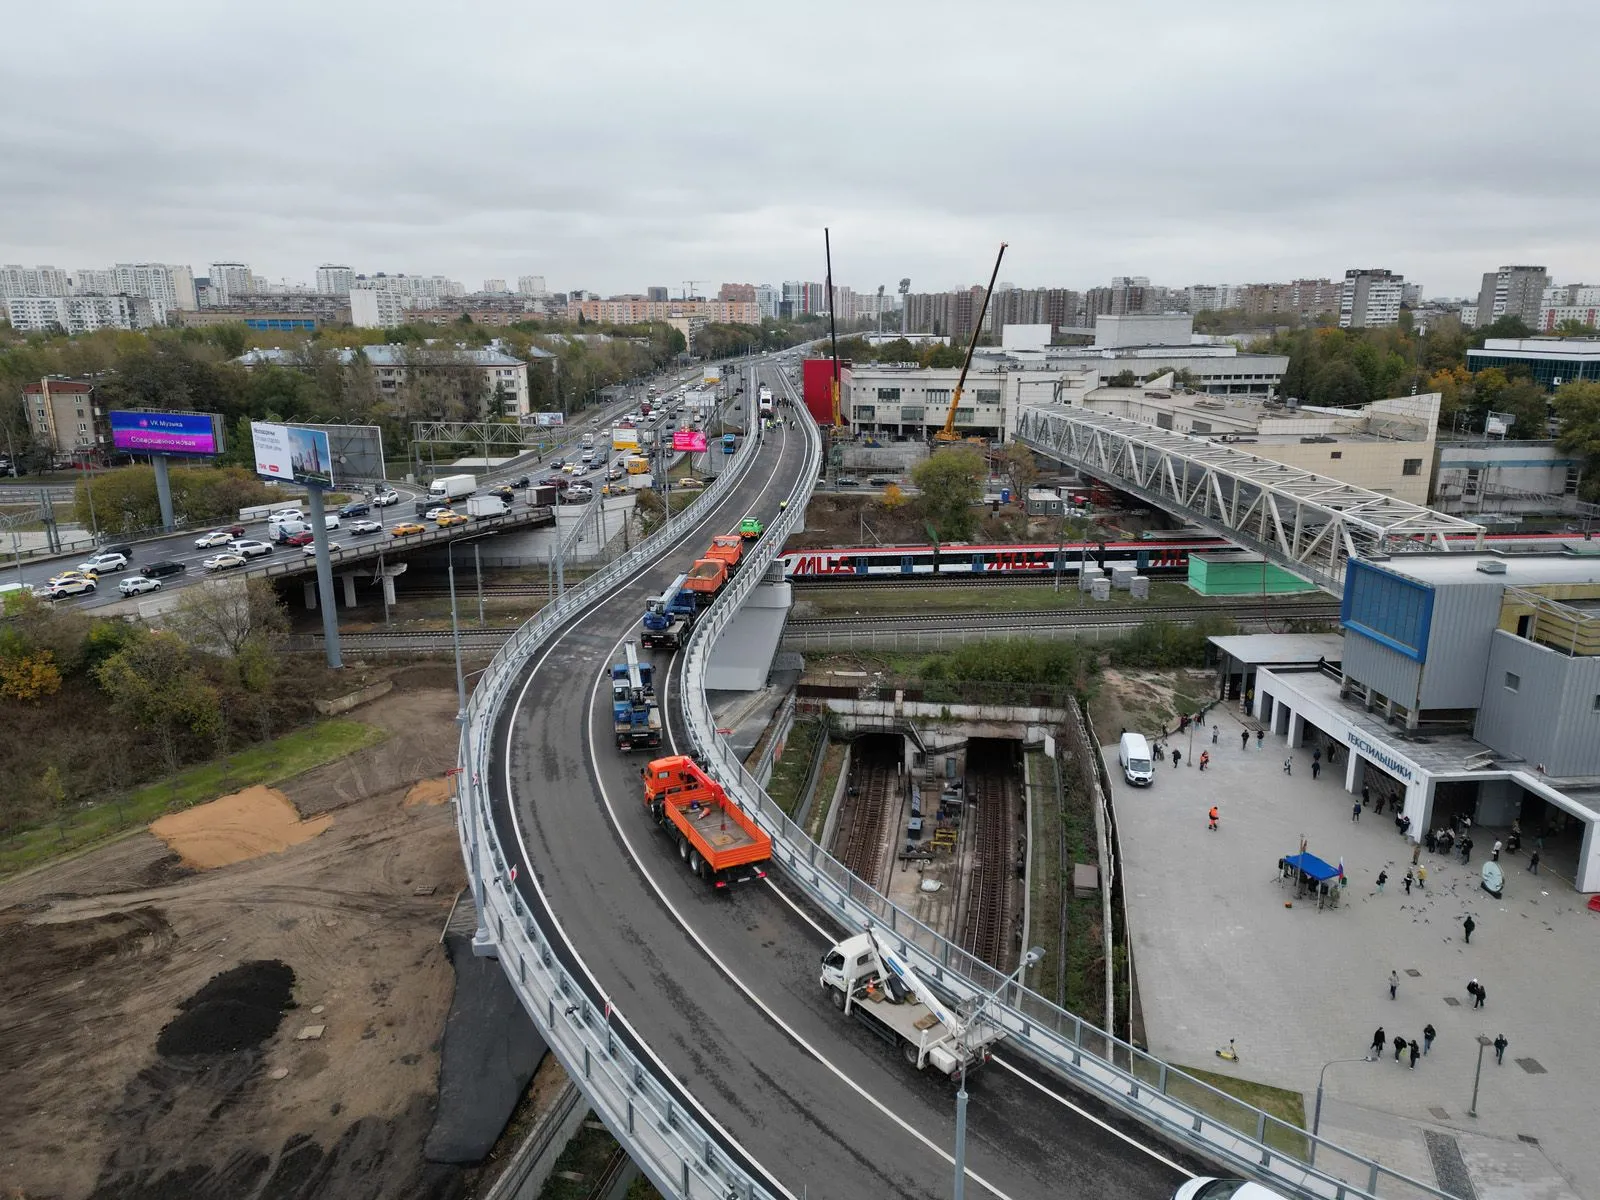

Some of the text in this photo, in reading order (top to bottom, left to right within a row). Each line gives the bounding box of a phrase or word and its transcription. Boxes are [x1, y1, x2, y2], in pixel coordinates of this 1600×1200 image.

[160, 420, 183, 428] Музыка
[130, 436, 175, 445] Совершенно
[793, 556, 854, 575] МЦД
[988, 551, 1050, 570] МЦД
[1347, 732, 1412, 781] ТЕКСТИЛЬЩИКИ
